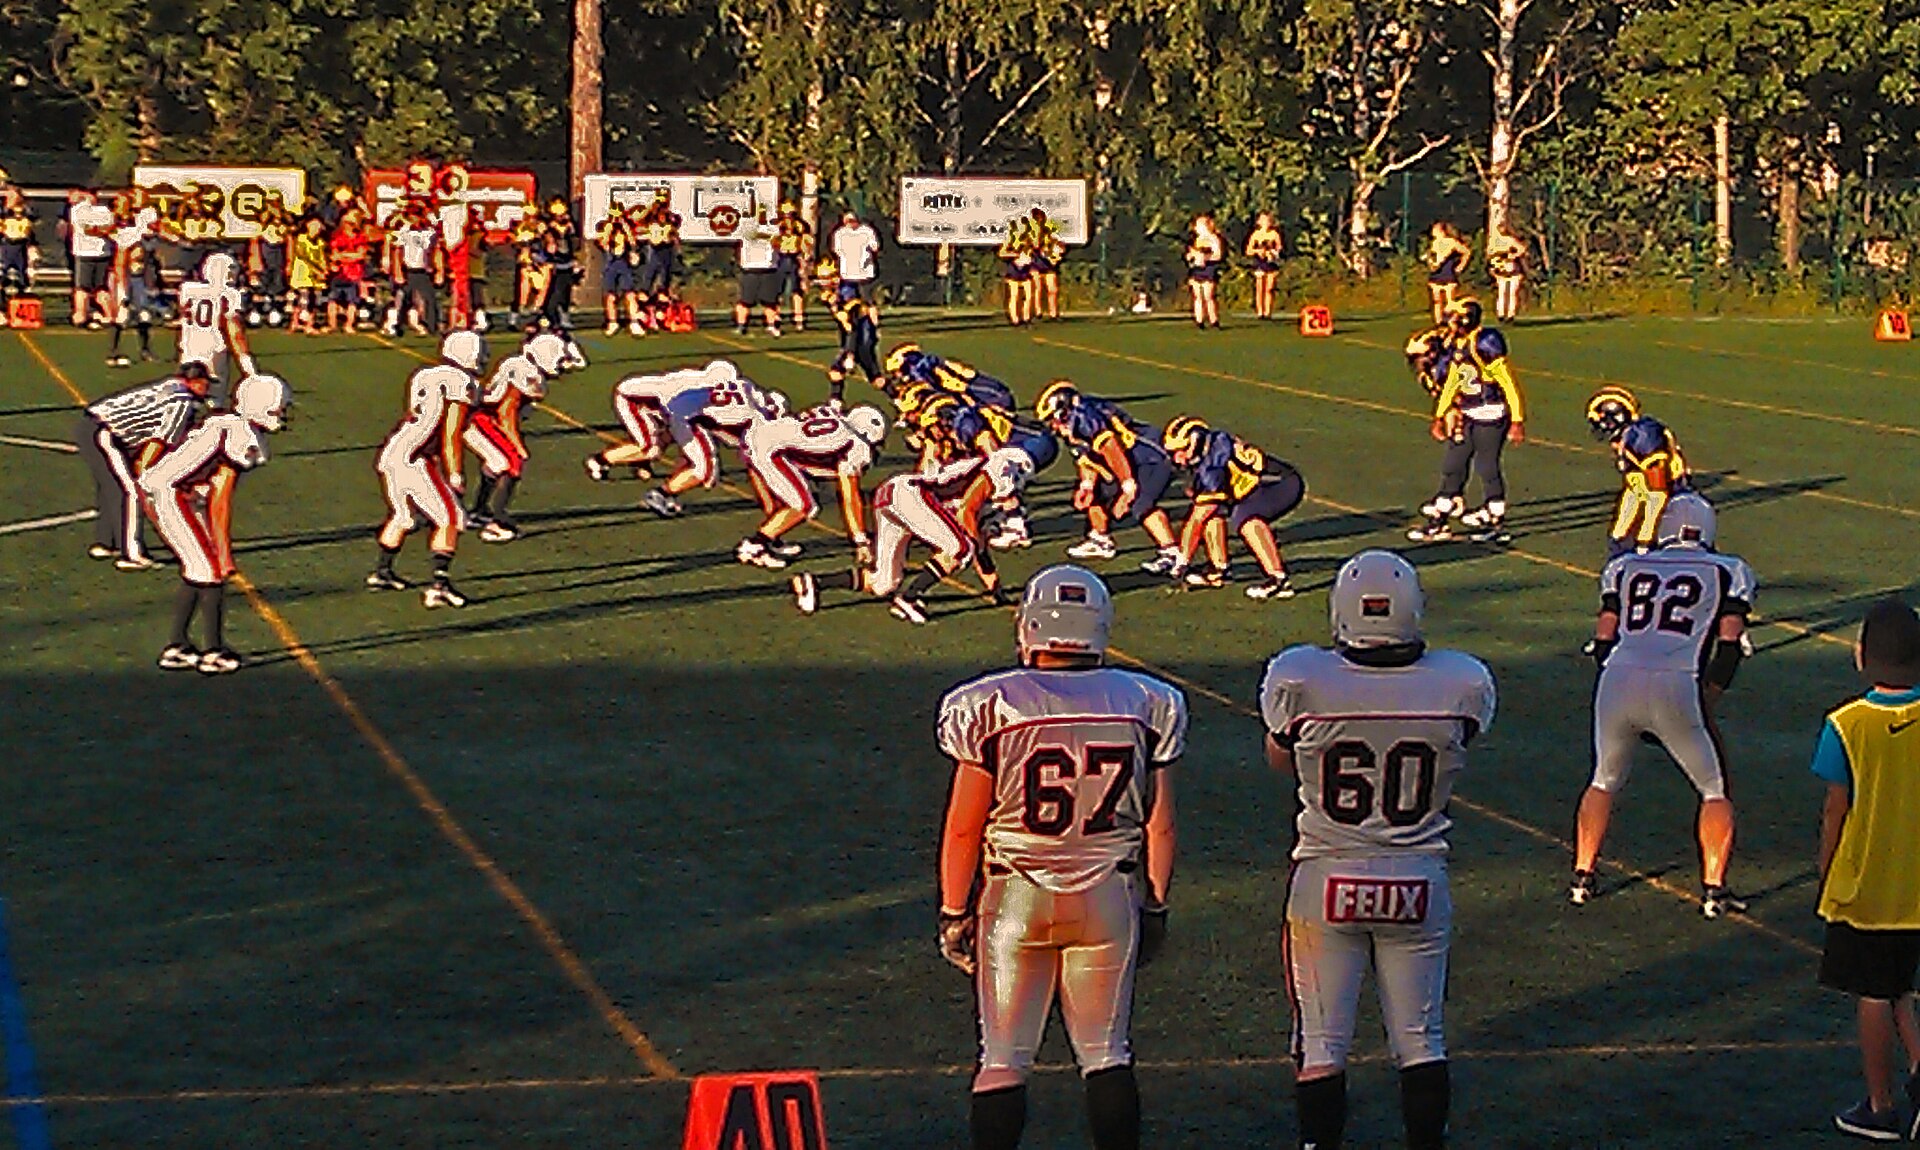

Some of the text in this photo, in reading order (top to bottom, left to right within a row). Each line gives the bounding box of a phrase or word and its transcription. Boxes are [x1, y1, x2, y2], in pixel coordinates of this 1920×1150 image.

[1308, 309, 1329, 329] 20
[1626, 571, 1703, 636] 82
[1022, 743, 1136, 836] 67
[1322, 739, 1439, 827] 60
[1333, 884, 1422, 920] FELIX
